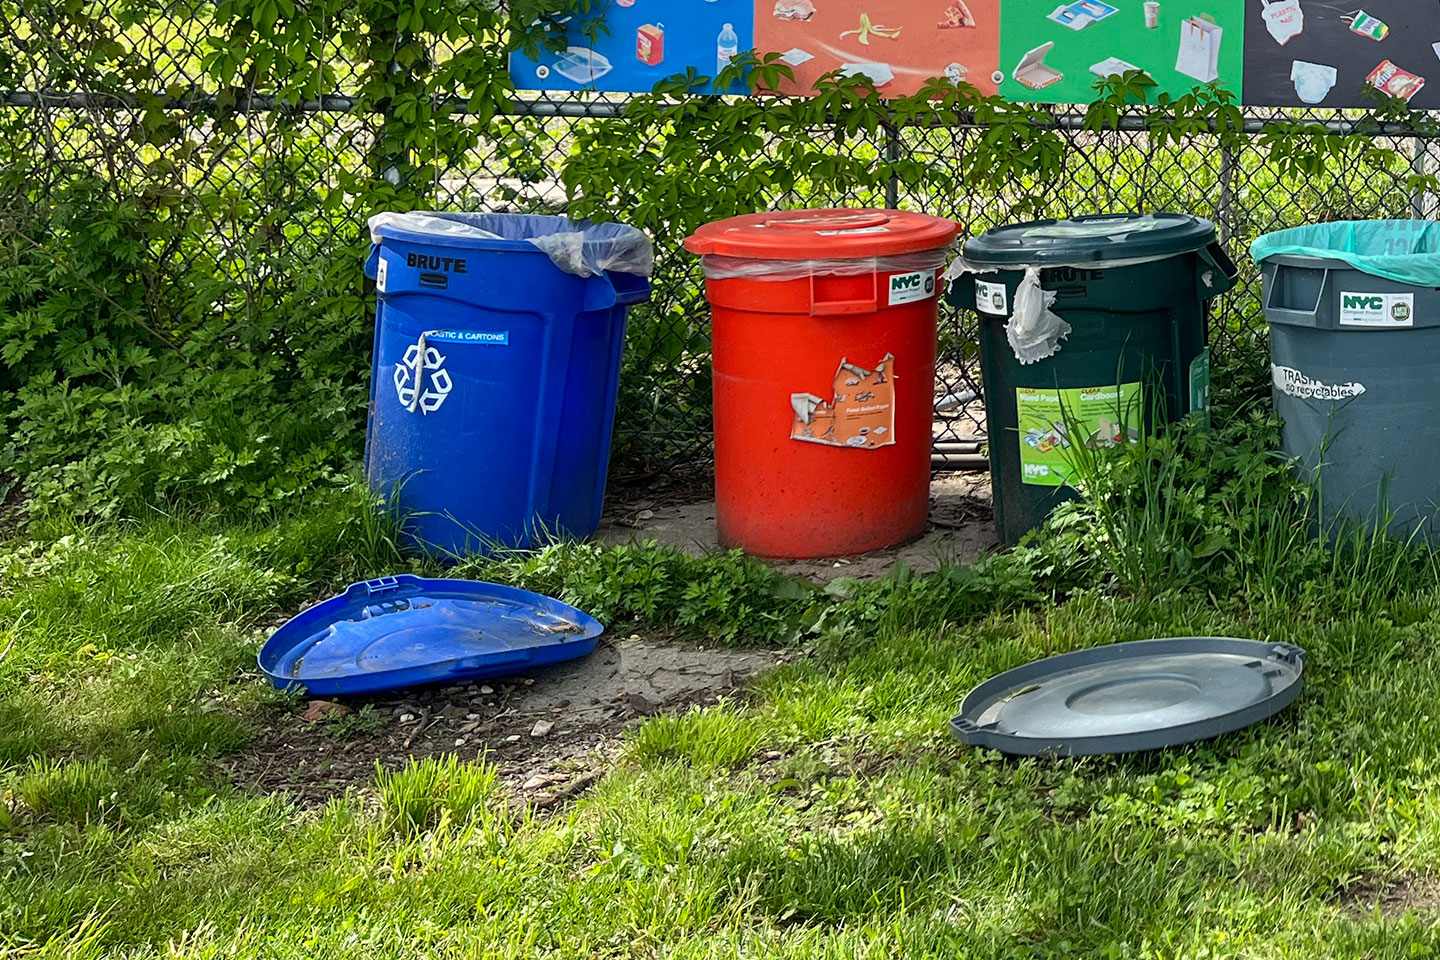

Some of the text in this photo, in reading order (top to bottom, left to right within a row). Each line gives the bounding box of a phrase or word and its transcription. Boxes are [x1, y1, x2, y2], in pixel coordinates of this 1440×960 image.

[407, 252, 468, 274] BRUTE
[892, 274, 921, 290] NYC
[1343, 295, 1383, 310] NYC
[465, 332, 505, 341] CARTONS
